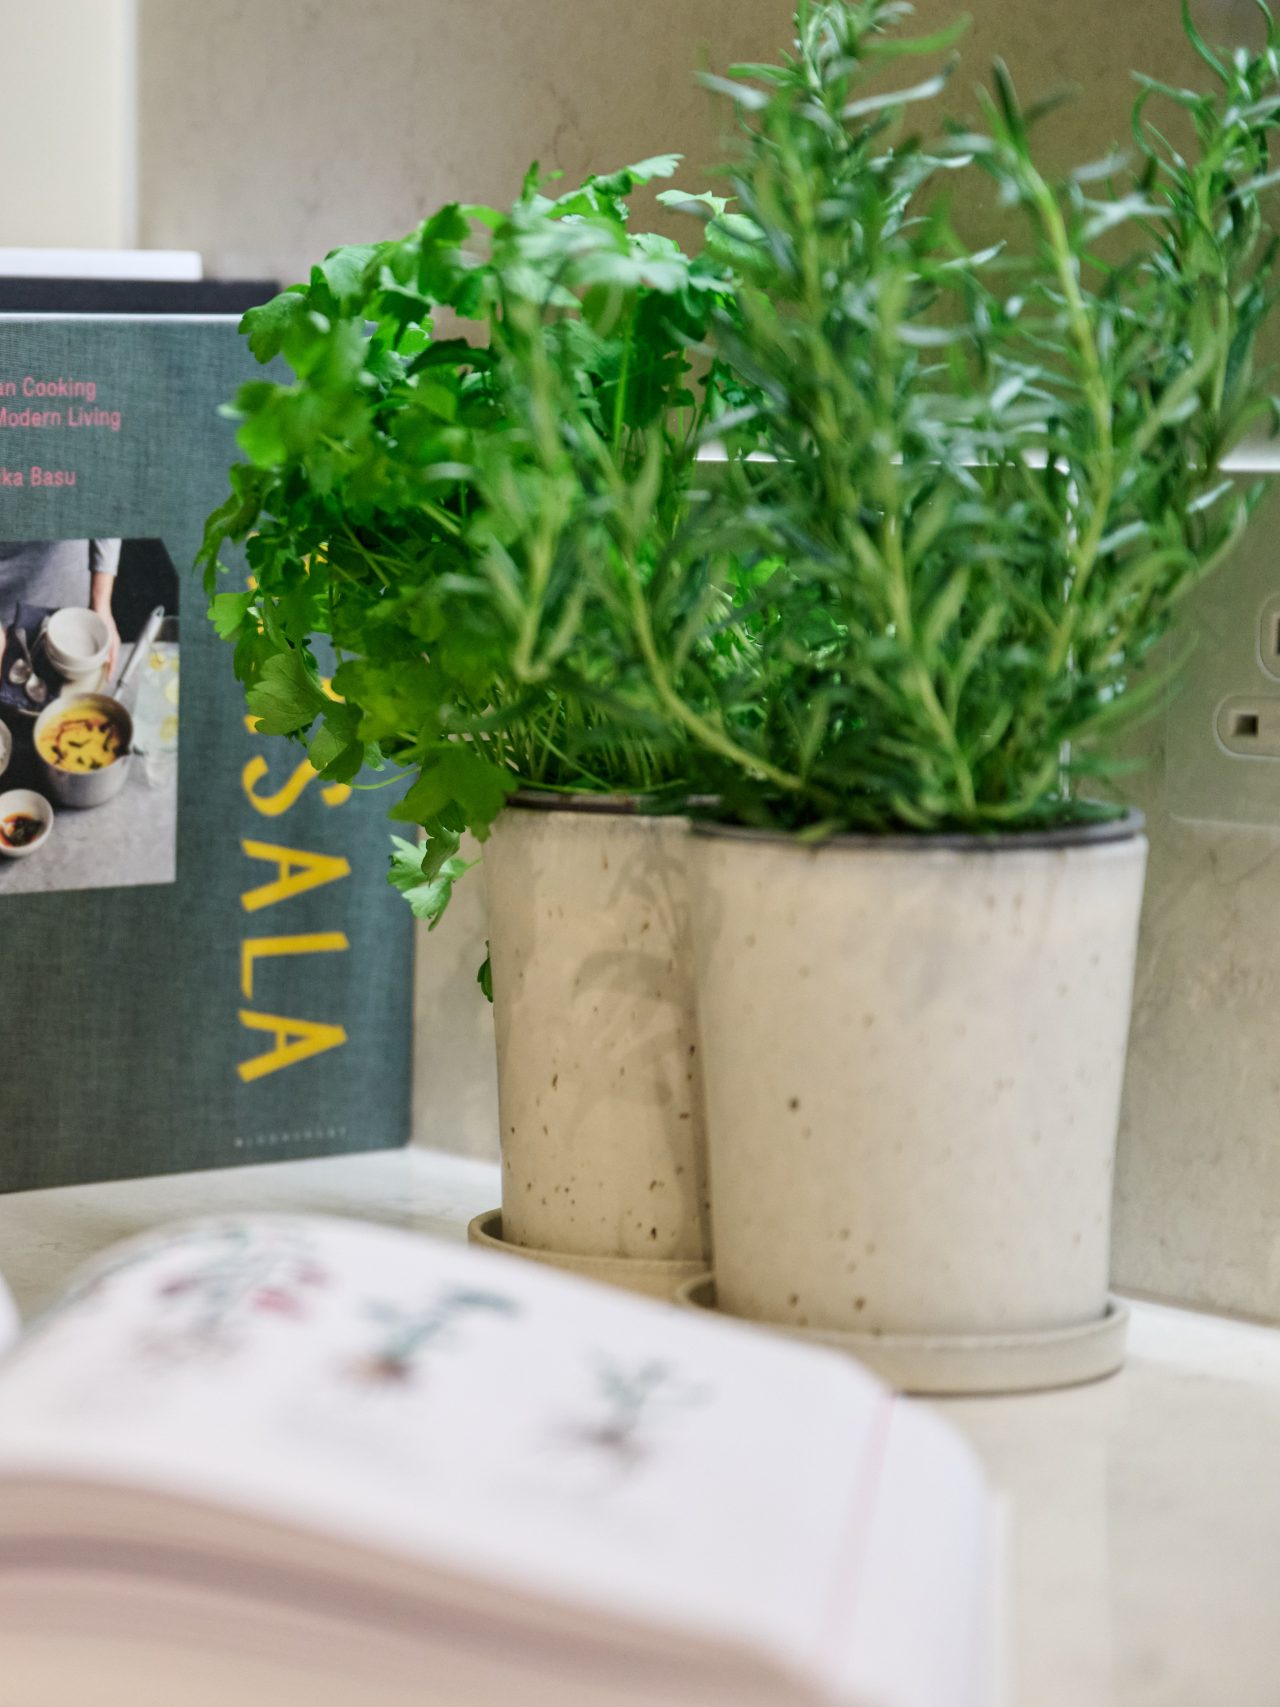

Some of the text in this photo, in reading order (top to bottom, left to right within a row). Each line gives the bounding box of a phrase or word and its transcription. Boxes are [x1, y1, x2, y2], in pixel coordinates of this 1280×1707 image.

[22, 376, 97, 402] Cooking
[67, 406, 122, 431] Living
[30, 466, 76, 486] Basu
